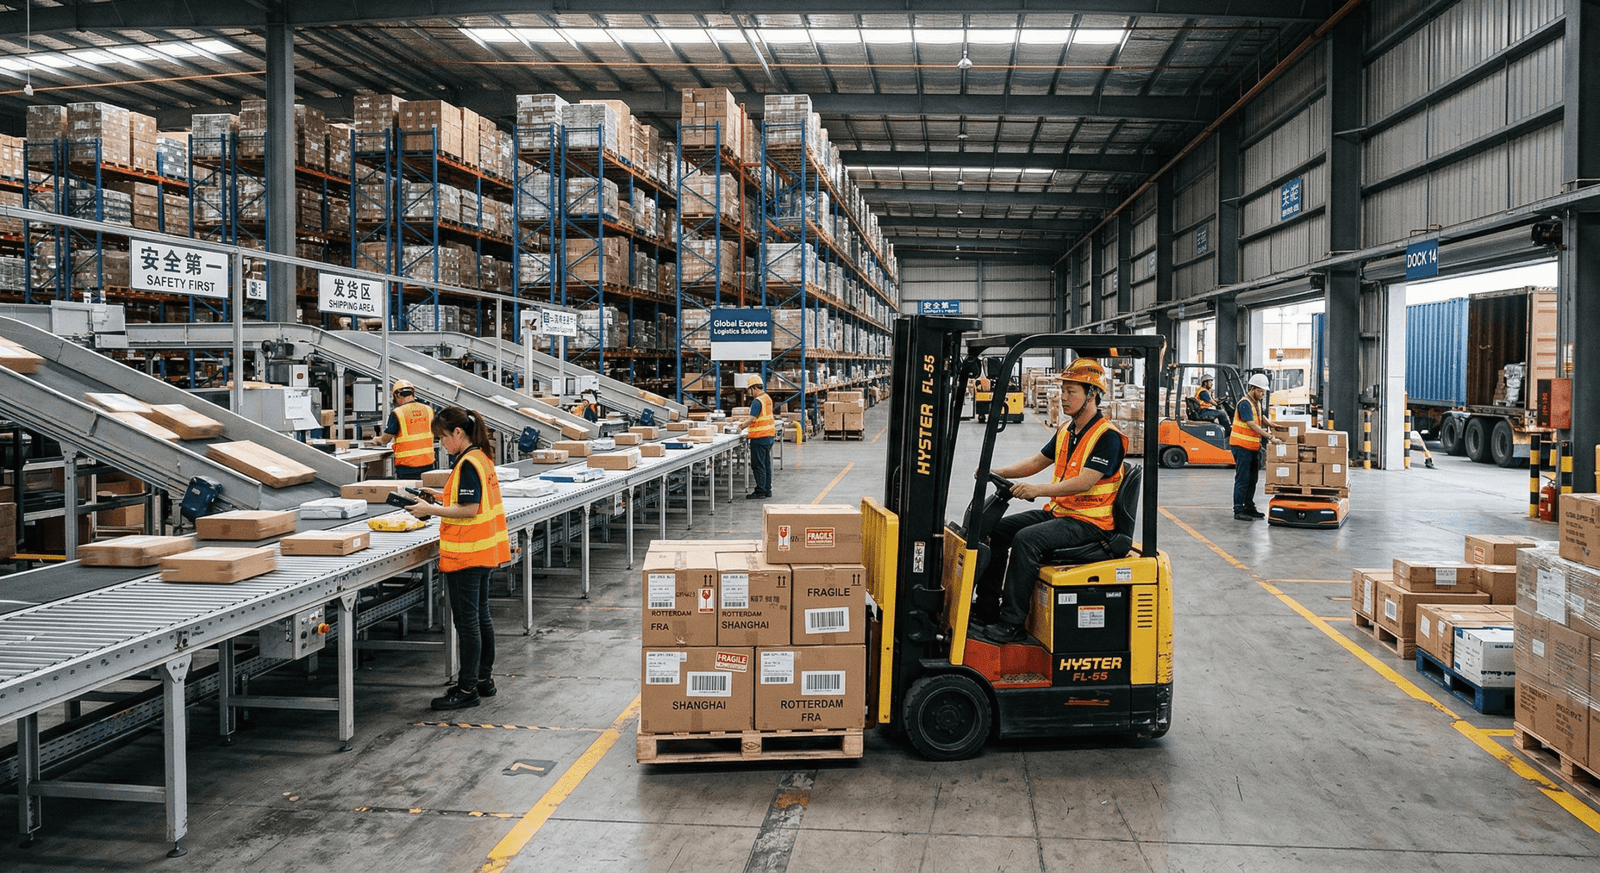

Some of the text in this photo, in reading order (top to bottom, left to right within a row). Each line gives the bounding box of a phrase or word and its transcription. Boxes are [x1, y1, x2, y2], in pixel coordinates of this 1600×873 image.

[140, 246, 222, 276] 安全第一
[1407, 248, 1437, 267] DOCK 14
[146, 274, 215, 292] SAFETY FIRST
[333, 278, 371, 300] 发货区
[328, 299, 375, 312] SHIPPING AREA
[713, 319, 768, 328] Global Express
[713, 328, 740, 336] Logistics
[917, 354, 935, 475] HYSTER FL-55
[807, 587, 851, 597] FRAGILE
[650, 622, 670, 631] FRA
[721, 620, 769, 630] SHANGHAI
[717, 654, 747, 664] FRAGILE
[1059, 656, 1123, 671] HYSTER
[1072, 671, 1108, 682] FL-55
[672, 701, 726, 710] SHANGHAI
[780, 699, 844, 709] ROTTERDAM
[801, 713, 822, 722] FRA
